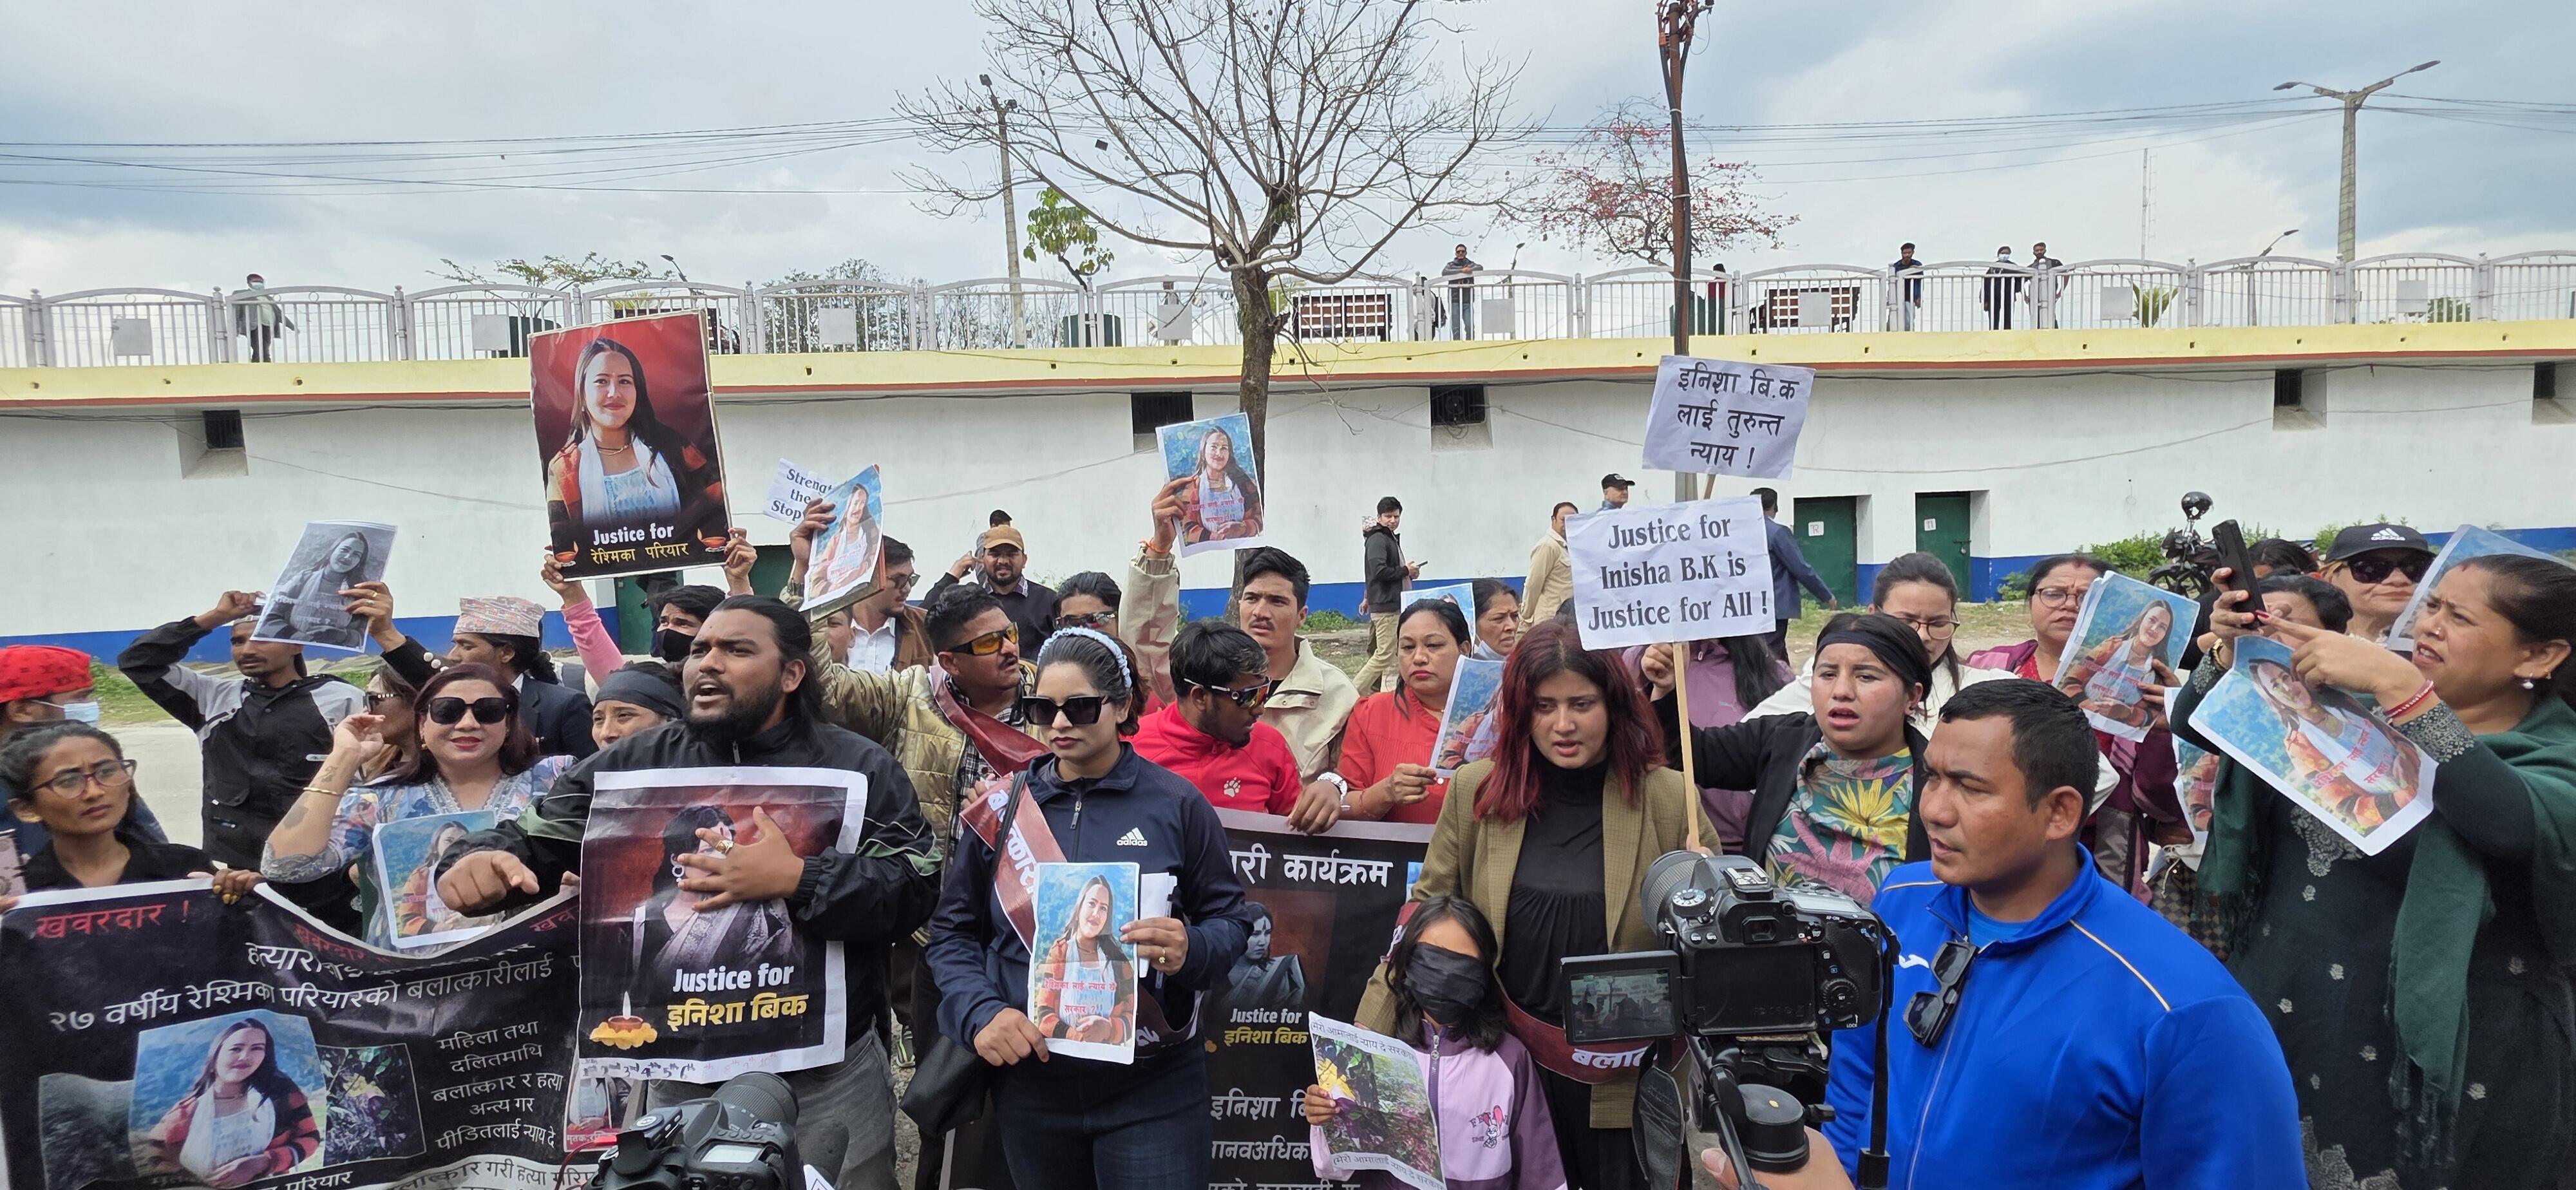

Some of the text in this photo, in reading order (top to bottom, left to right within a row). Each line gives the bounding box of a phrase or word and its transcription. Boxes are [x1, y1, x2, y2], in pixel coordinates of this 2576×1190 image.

[1678, 362, 1799, 401] इनिशा बि.क
[1677, 400, 1785, 439] लाई तुरुन्त
[1690, 442, 1755, 469] न्याय !
[786, 469, 832, 496] Strengt
[790, 489, 811, 504] the
[772, 500, 801, 522] Stop
[594, 523, 674, 545] Justice for
[1608, 514, 1730, 549] Justice for
[591, 542, 689, 565] रेश्मिका परियार
[1600, 551, 1745, 590] Inisha B.K is
[1589, 591, 1767, 631] Justice for All !
[1229, 843, 1393, 887] ारी कार्यक्रम
[49, 1012, 95, 1031] २७
[104, 988, 182, 1024] वर्षीय
[184, 980, 276, 1009] रेश्मिका
[279, 980, 401, 1008] परियारको
[406, 952, 554, 999] बलात्कारीलाई
[672, 963, 794, 992] Justice for
[667, 993, 809, 1032] इनिशा बिक
[1230, 1008, 1302, 1024] Justice for
[437, 1021, 538, 1050] महिला तथा
[1224, 1026, 1309, 1047] इनिशा बिक
[450, 1043, 542, 1073] दलितमाथि
[430, 1073, 563, 1102] बलात्कार र हत्या
[469, 1098, 535, 1115] अन्त्य गर
[1210, 1087, 1282, 1120] इनिशा
[435, 1118, 556, 1149] पीडितलाई न्याय दे
[392, 1162, 482, 1190] लात्कार
[485, 1159, 514, 1178] गरी
[516, 1165, 546, 1185] हत्या
